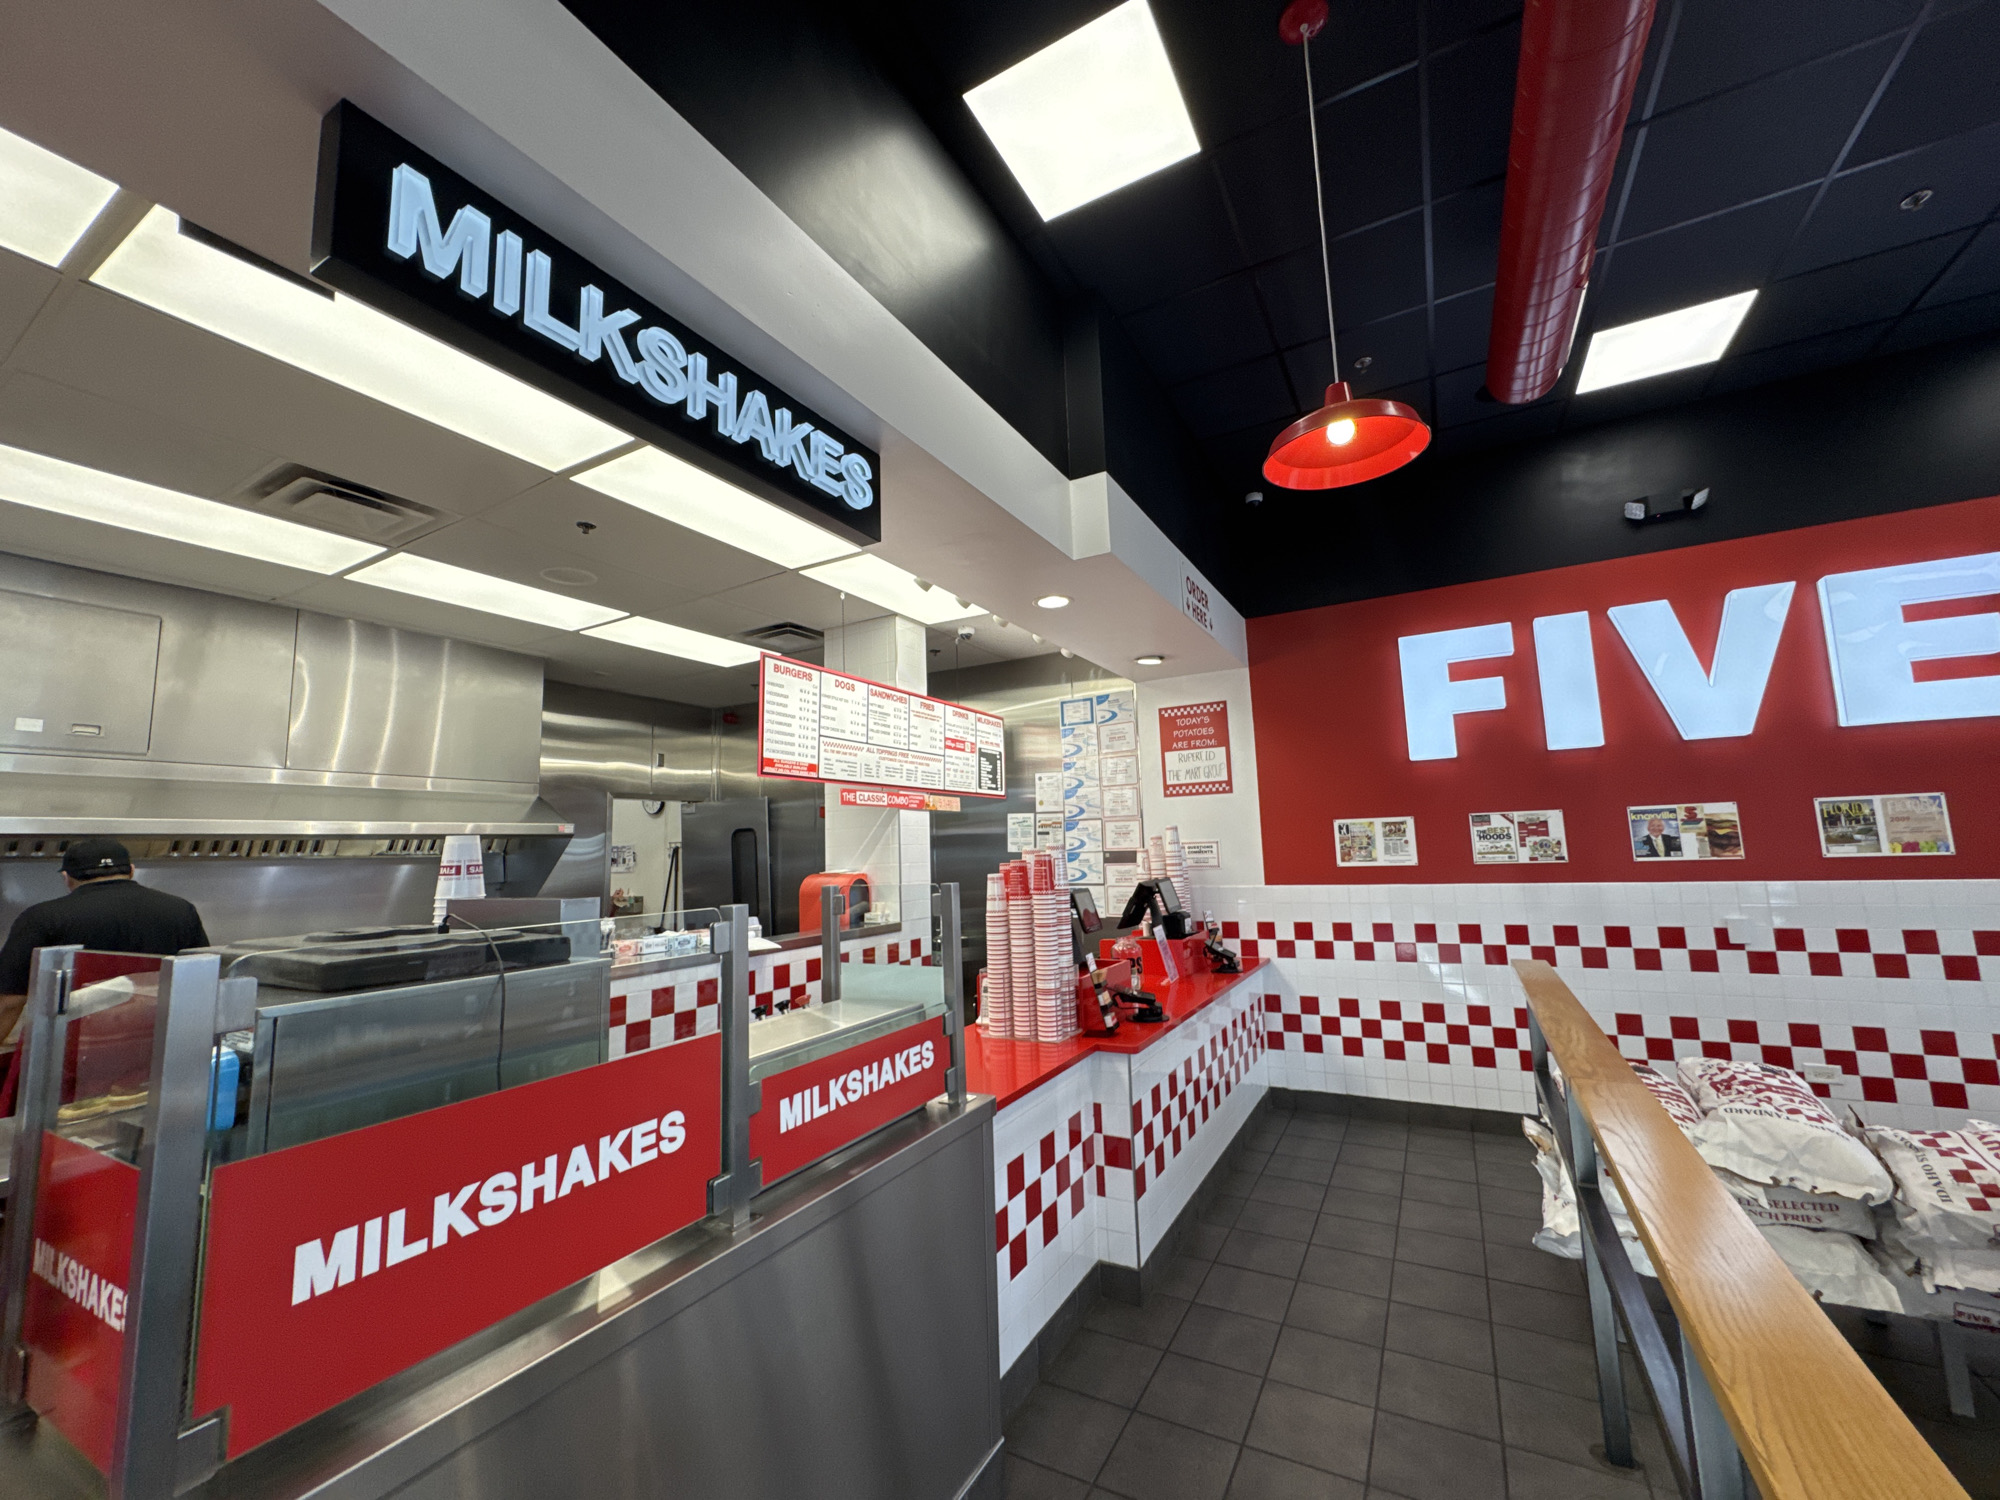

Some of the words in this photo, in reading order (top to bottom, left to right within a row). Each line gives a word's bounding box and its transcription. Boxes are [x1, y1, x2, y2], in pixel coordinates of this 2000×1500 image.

[387, 162, 873, 510] MILKSHAKES
[1186, 576, 1209, 612] ORDER
[1192, 601, 1207, 628] HERE
[1398, 551, 2000, 761] FIVE
[773, 663, 813, 682] BURGERS
[835, 679, 855, 692] DOGS
[869, 688, 907, 704] SANDWICHES
[920, 701, 935, 712] FRIES
[1176, 716, 1210, 727] TODAY'S
[1173, 727, 1214, 738] POTATOES
[1172, 741, 1188, 750] ARE
[1191, 738, 1217, 748] FROM:
[876, 748, 898, 756] TOPPINGS
[1168, 770, 1181, 781] THE
[842, 792, 856, 802] THE
[858, 793, 886, 803] CLASSIC
[888, 795, 909, 805] COMBO
[1630, 811, 1677, 820] knoxville
[1487, 826, 1511, 834] BEST
[780, 1040, 935, 1133] MILKSHAKES
[1921, 1163, 1954, 1204] IDAHO
[291, 1110, 686, 1307] MILKSHAKES
[1780, 1211, 1824, 1224] FRIES
